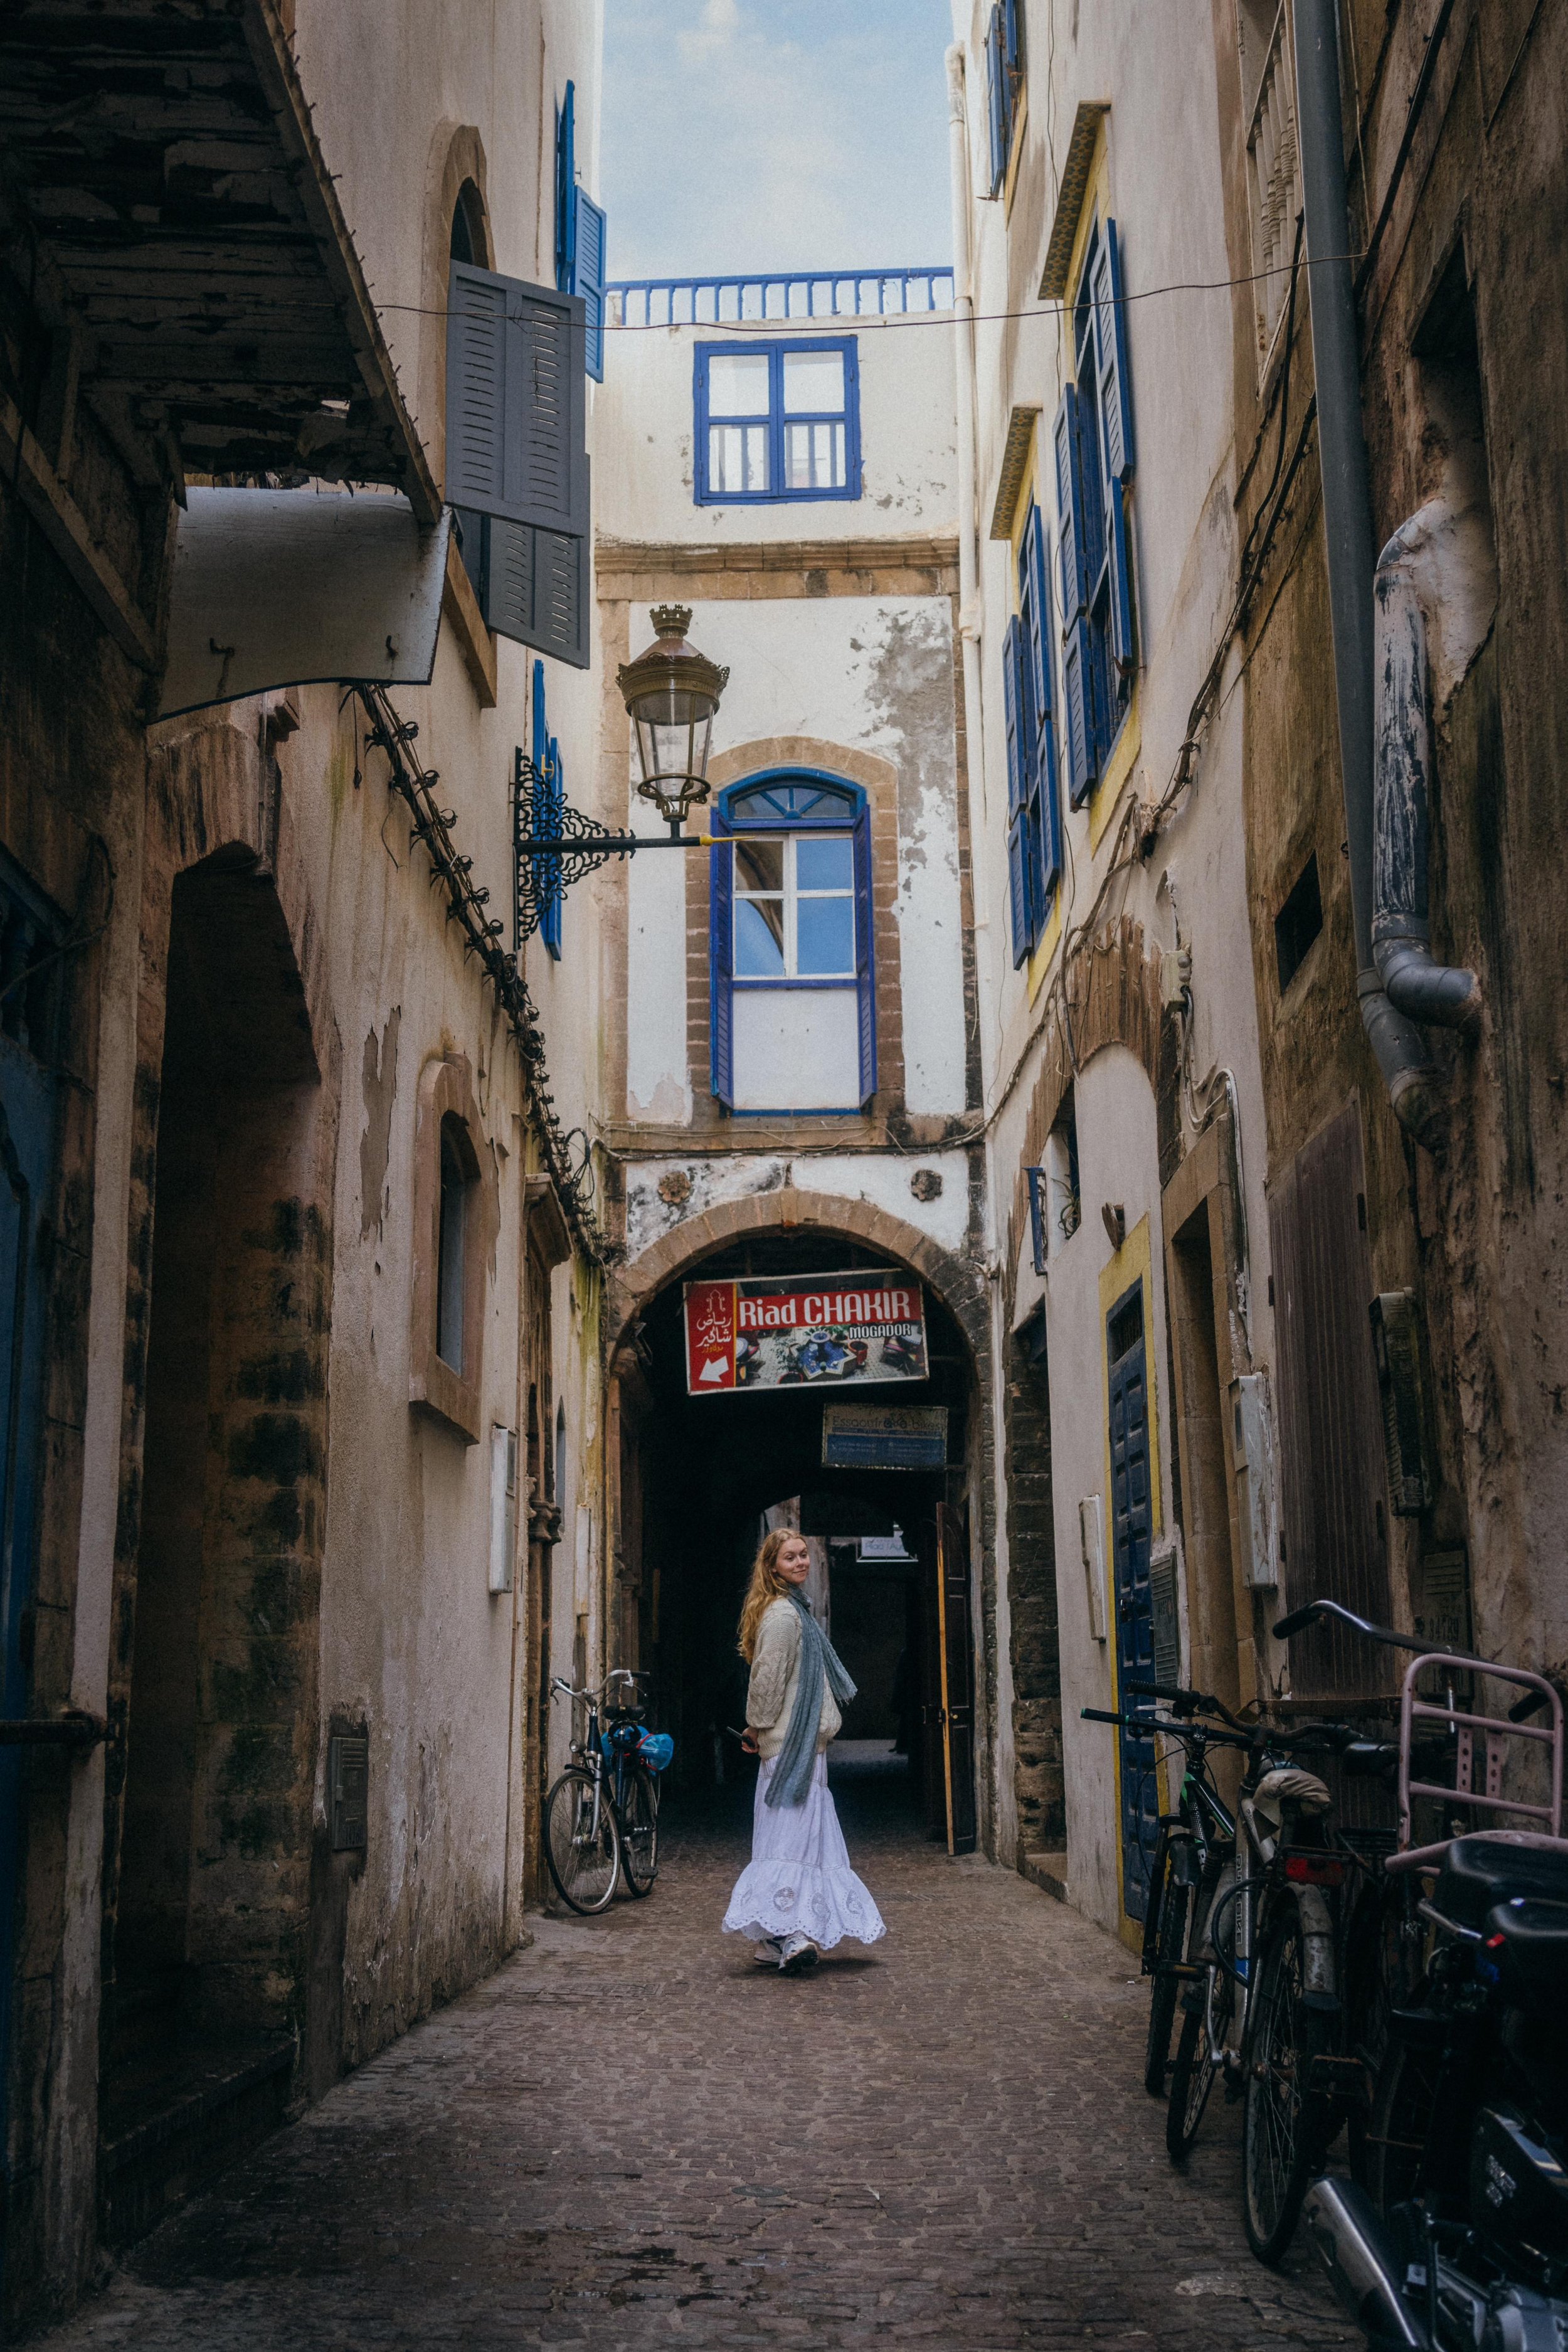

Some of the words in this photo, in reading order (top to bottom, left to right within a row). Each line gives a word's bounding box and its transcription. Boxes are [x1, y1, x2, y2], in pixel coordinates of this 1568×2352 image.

[739, 1298, 796, 1327] Riad
[803, 1290, 911, 1324] CHAKIR
[695, 1325, 732, 1348] شاكير
[849, 1323, 912, 1339] MOGADOR
